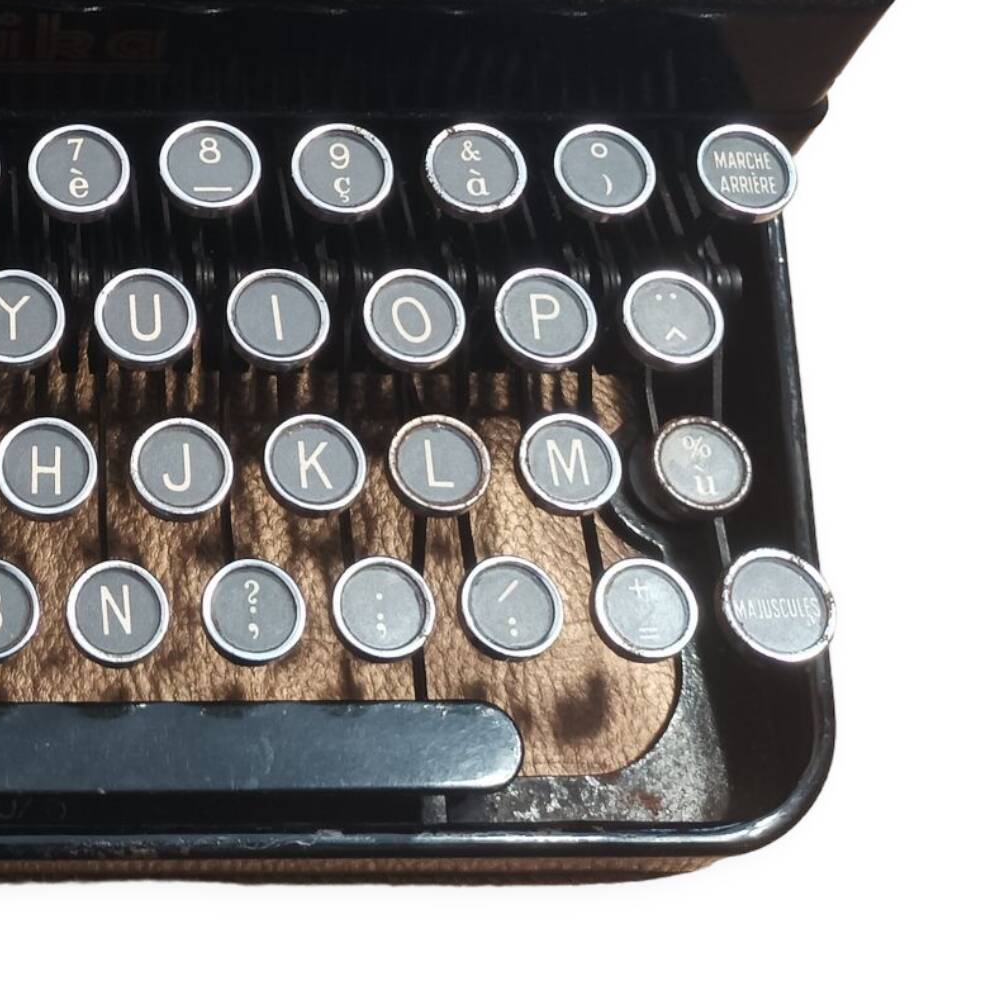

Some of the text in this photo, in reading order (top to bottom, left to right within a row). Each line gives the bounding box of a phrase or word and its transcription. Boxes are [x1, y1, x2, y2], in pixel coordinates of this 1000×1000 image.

[68, 139, 83, 160] 7
[200, 138, 220, 163] 8
[330, 143, 349, 169] 9
[461, 141, 480, 160] &
[713, 151, 773, 170] MARCHE
[70, 168, 88, 198] è
[334, 176, 350, 202] ç
[467, 168, 489, 196] à
[603, 175, 612, 195] )
[720, 172, 777, 194] ARRIÈRE
[130, 294, 161, 341] U
[272, 295, 282, 340] I
[392, 297, 431, 343] O
[530, 294, 559, 339] P
[682, 436, 711, 458] %
[32, 446, 60, 494] H
[163, 443, 190, 491] J
[298, 441, 332, 489] K
[425, 440, 454, 487] L
[547, 439, 589, 486] M
[695, 465, 717, 496] ù
[245, 580, 259, 613] ?
[628, 578, 649, 598] +
[101, 585, 131, 635] N
[732, 597, 821, 620] MAJUSCULES
[640, 628, 660, 639] =
